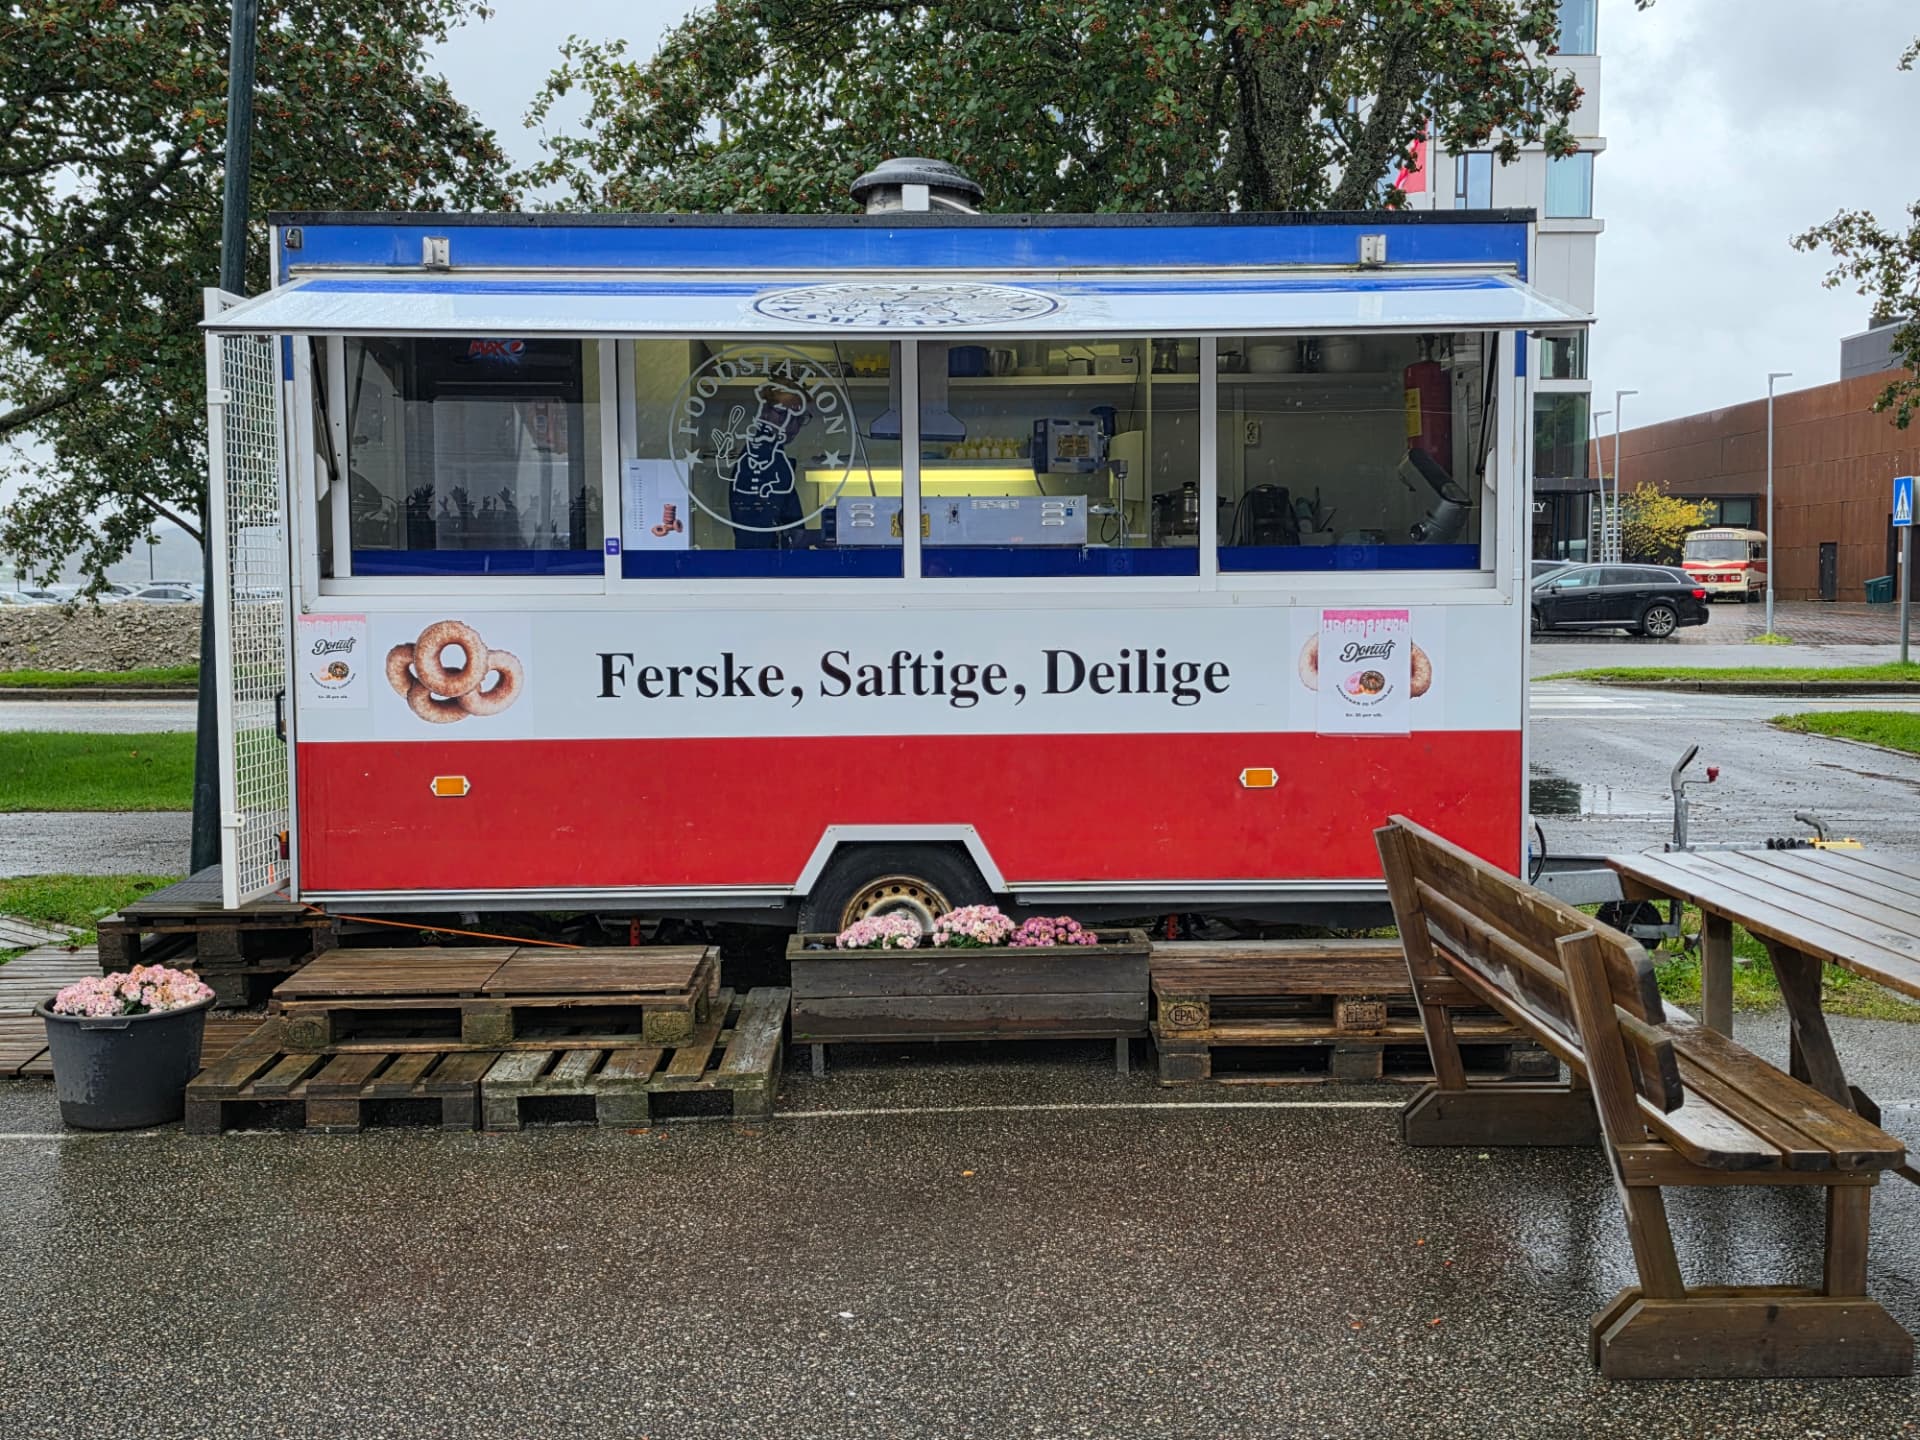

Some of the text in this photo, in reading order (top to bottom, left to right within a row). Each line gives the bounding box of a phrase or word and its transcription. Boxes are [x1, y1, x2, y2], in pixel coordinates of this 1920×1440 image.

[678, 354, 847, 437] FOODSTATION
[311, 636, 357, 656] Donuts
[1339, 639, 1397, 663] Donuts
[595, 648, 1231, 709] Ferske, Saftige, Deilige
[1174, 1009, 1198, 1022] EPAL
